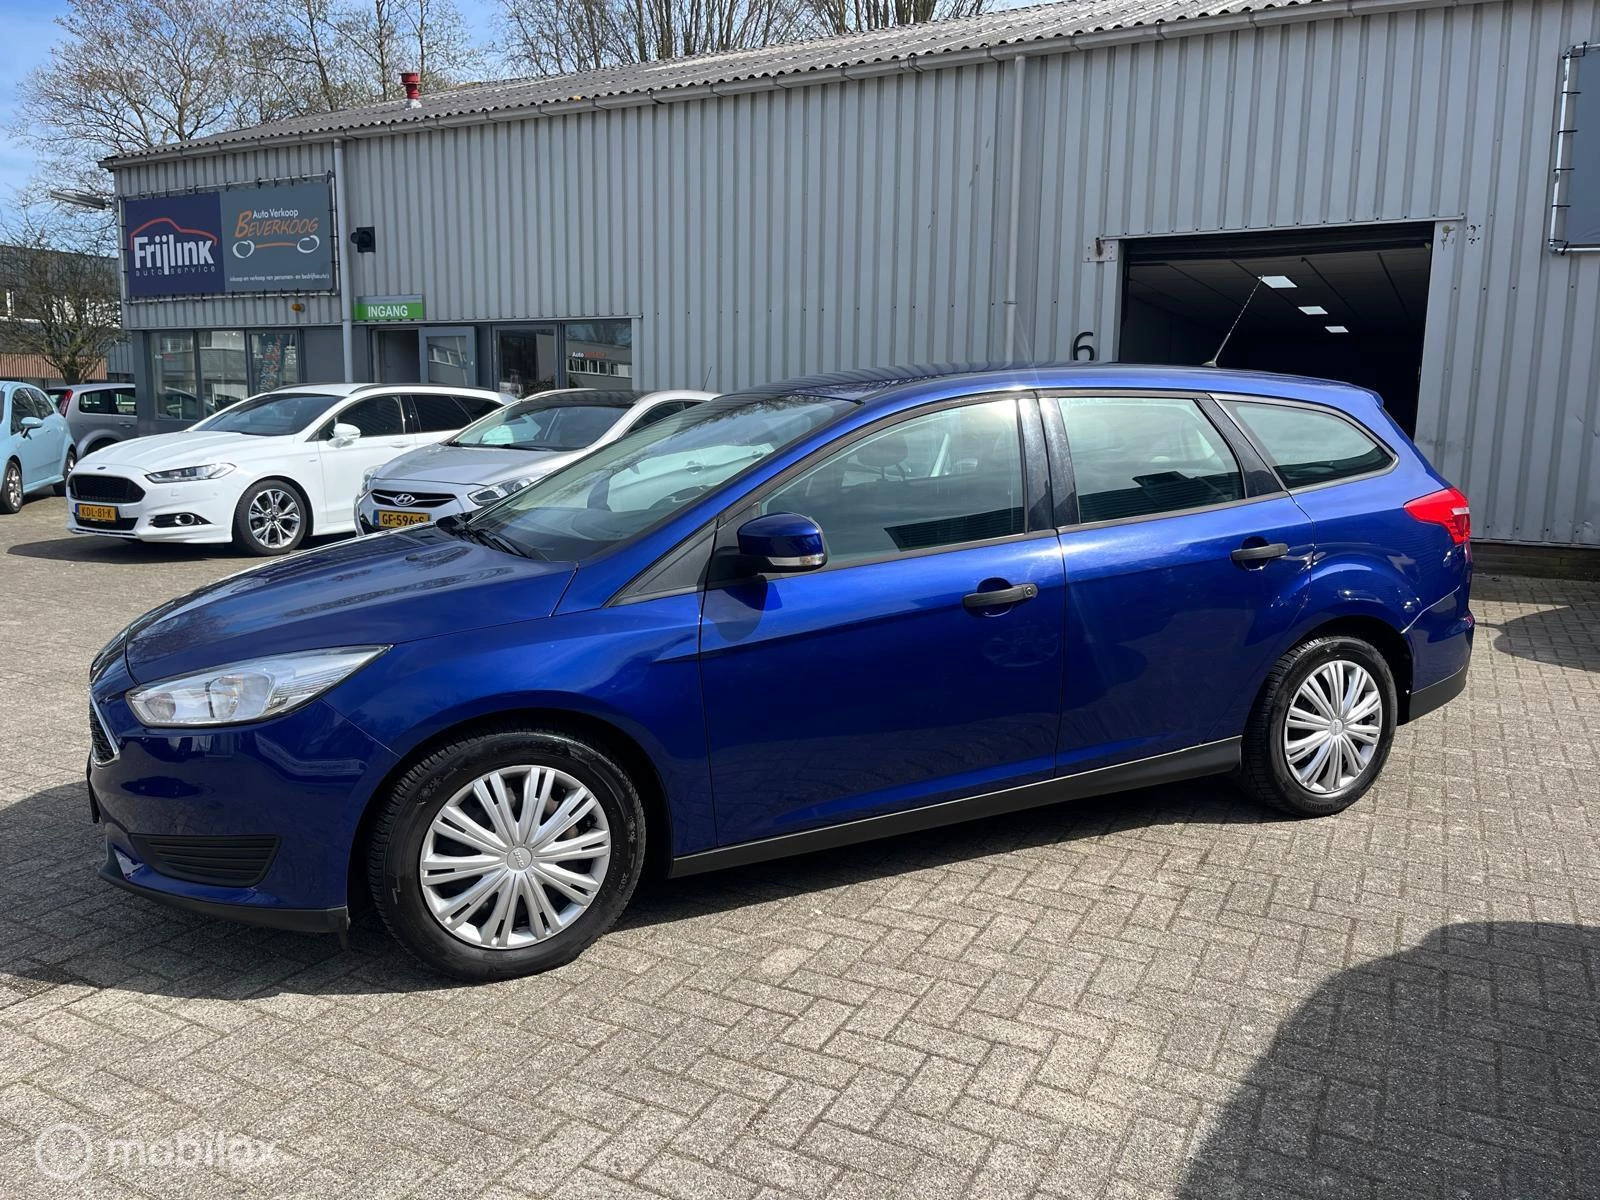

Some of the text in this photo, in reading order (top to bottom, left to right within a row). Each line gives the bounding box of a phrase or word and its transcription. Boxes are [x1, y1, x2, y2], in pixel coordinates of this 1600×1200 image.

[252, 207, 299, 219] Auto Verkoop
[234, 210, 319, 238] BEVERKOOG
[368, 305, 408, 318] INGANG
[1073, 331, 1095, 361] 6
